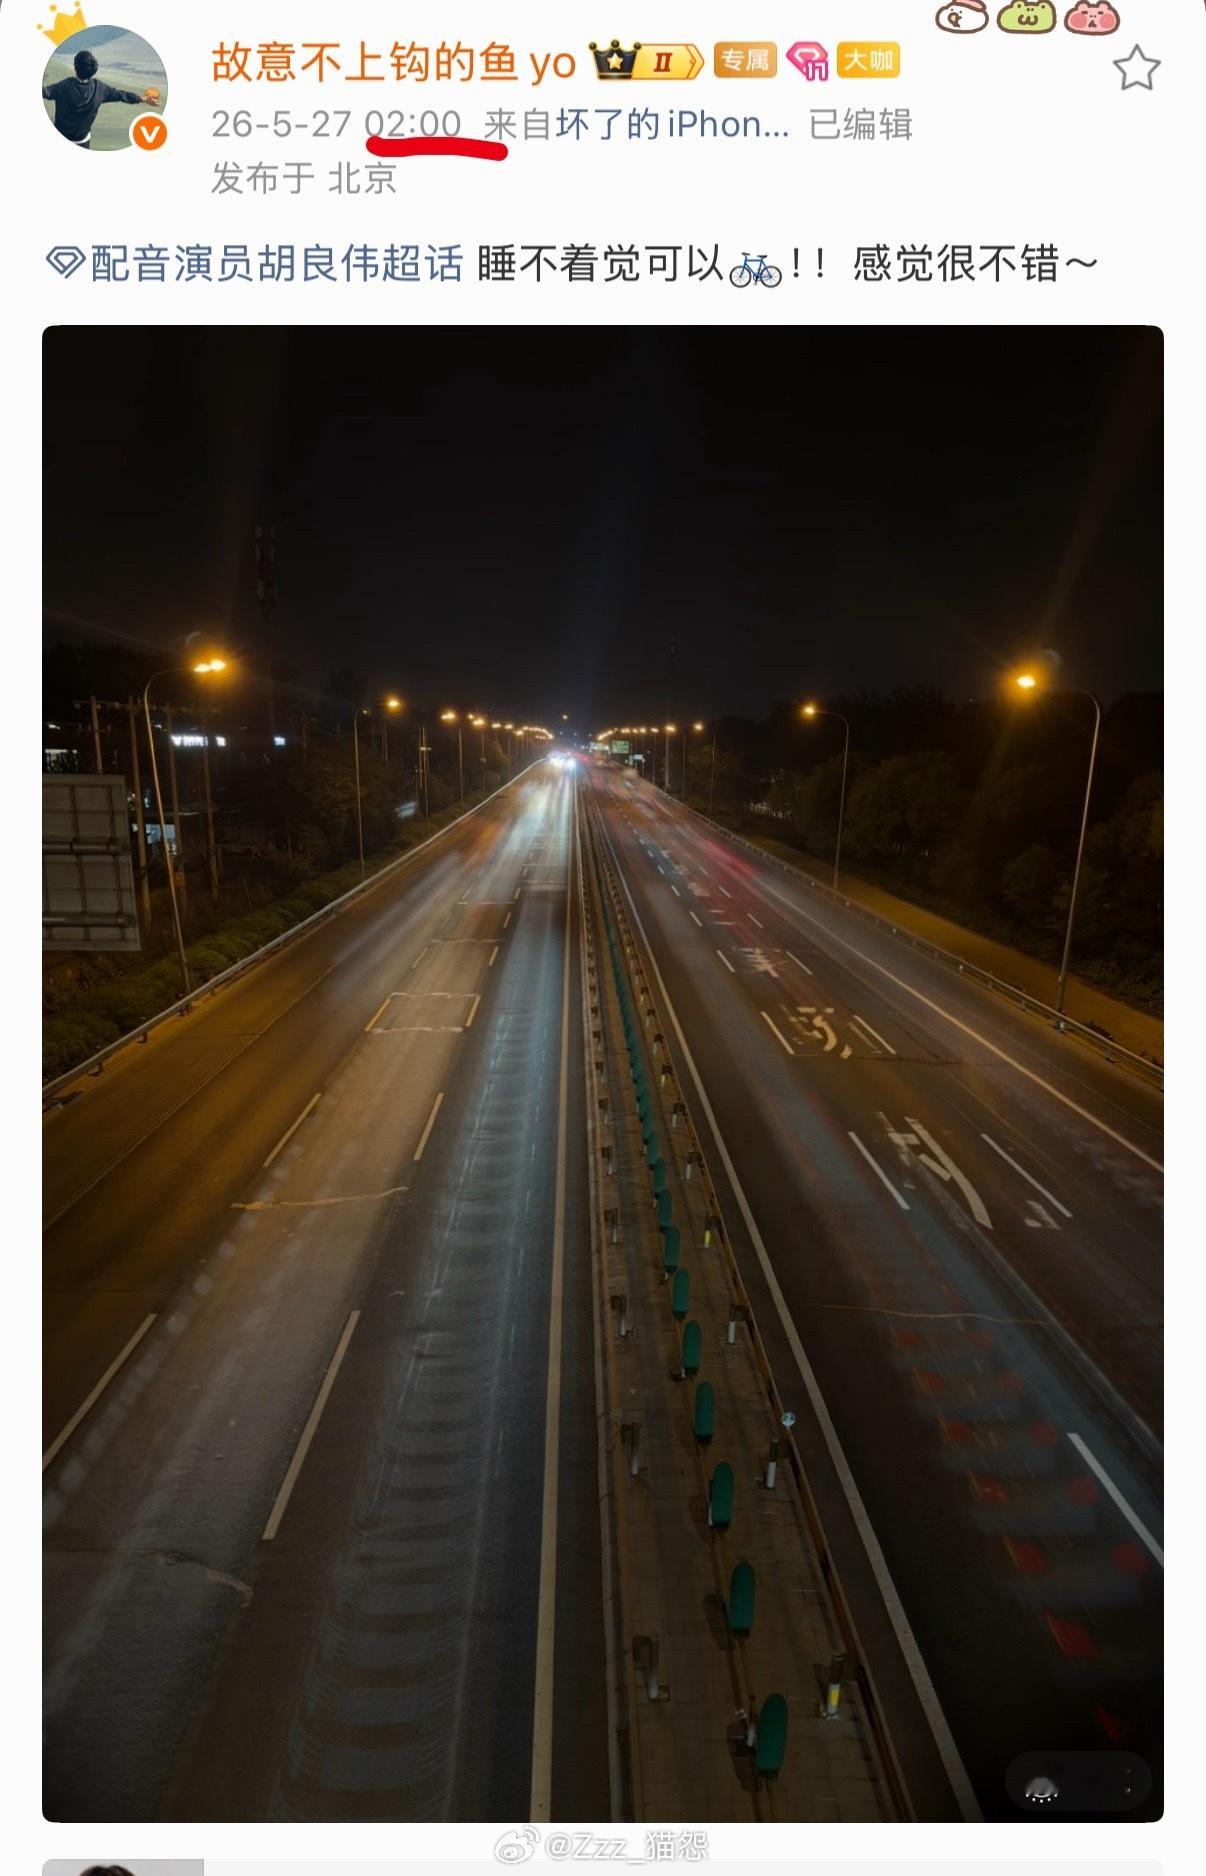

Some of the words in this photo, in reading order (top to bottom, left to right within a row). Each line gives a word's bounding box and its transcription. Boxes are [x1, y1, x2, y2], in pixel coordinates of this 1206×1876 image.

[211, 40, 520, 84] 故意不上钩的鱼
[529, 52, 577, 85] yo
[720, 47, 770, 73] 专属
[843, 47, 894, 72] 大咖
[212, 109, 352, 138] 26-5-27
[364, 109, 462, 138] 02:00
[809, 106, 913, 141] 已编辑
[211, 160, 315, 196] 发布于
[328, 160, 397, 196] 北京
[90, 242, 464, 283] 配音演员胡良伟超话
[478, 242, 724, 283] 睡不着觉可以
